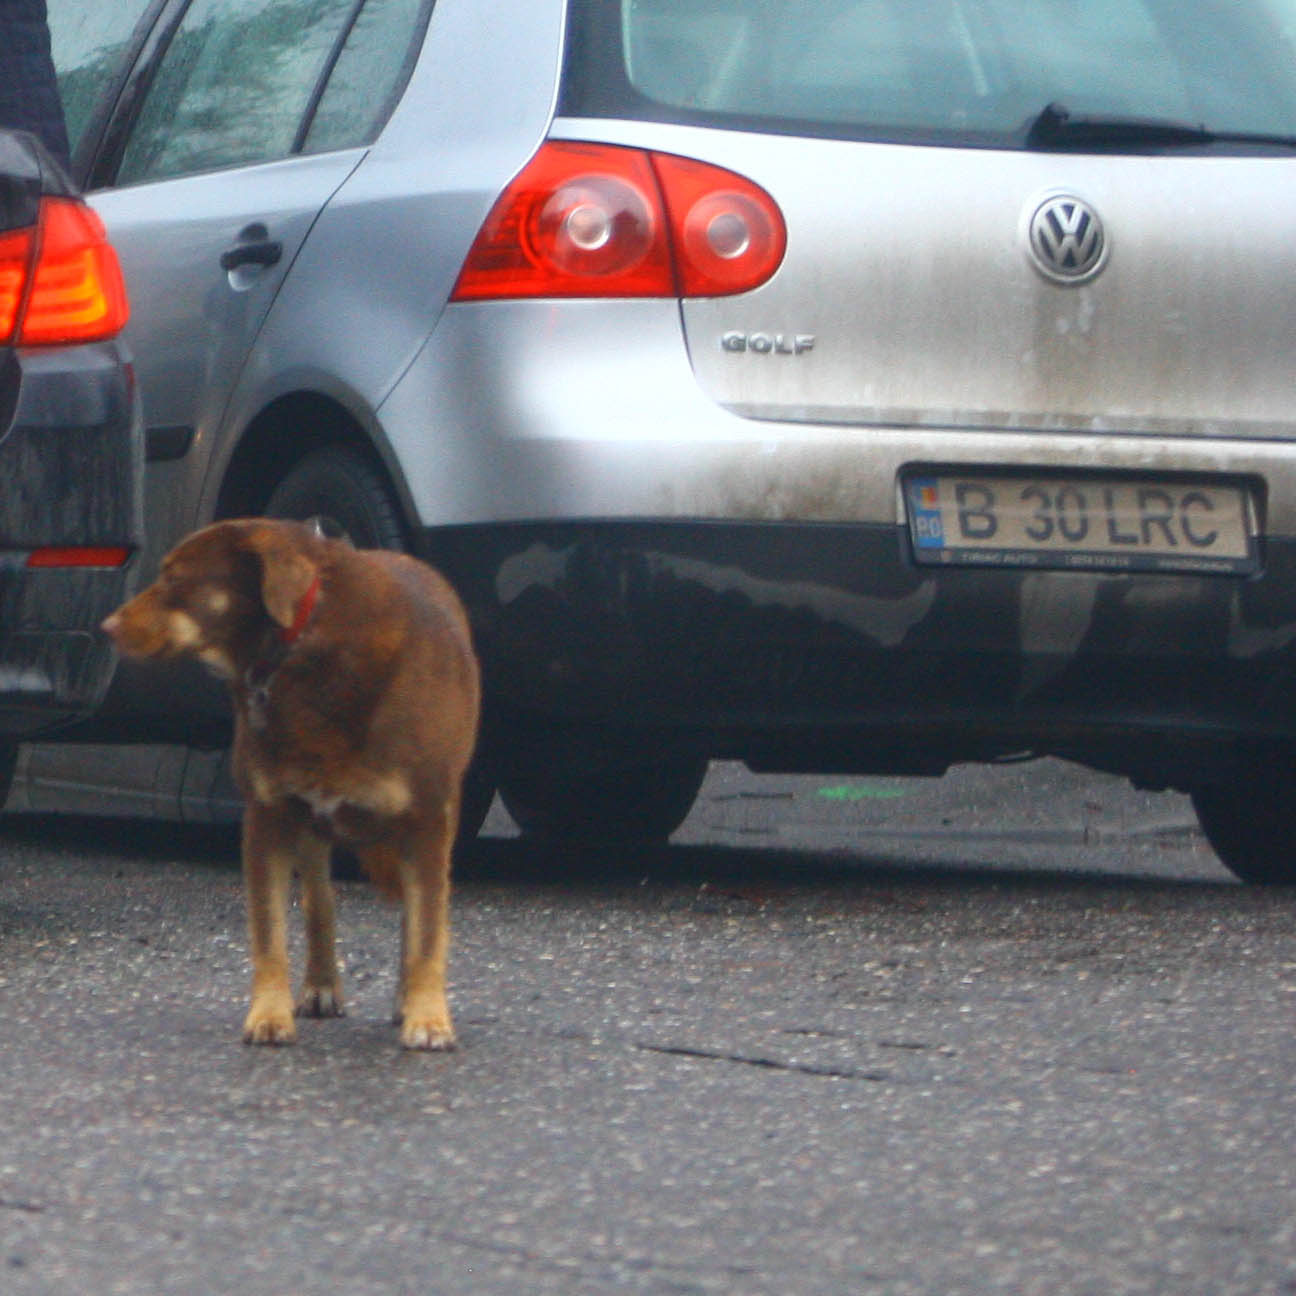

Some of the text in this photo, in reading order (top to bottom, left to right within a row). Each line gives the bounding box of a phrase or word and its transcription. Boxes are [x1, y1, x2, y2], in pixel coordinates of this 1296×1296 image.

[721, 330, 816, 356] GOLF
[954, 482, 999, 540] B
[1020, 484, 1090, 542] 30
[1104, 487, 1218, 548] LRC
